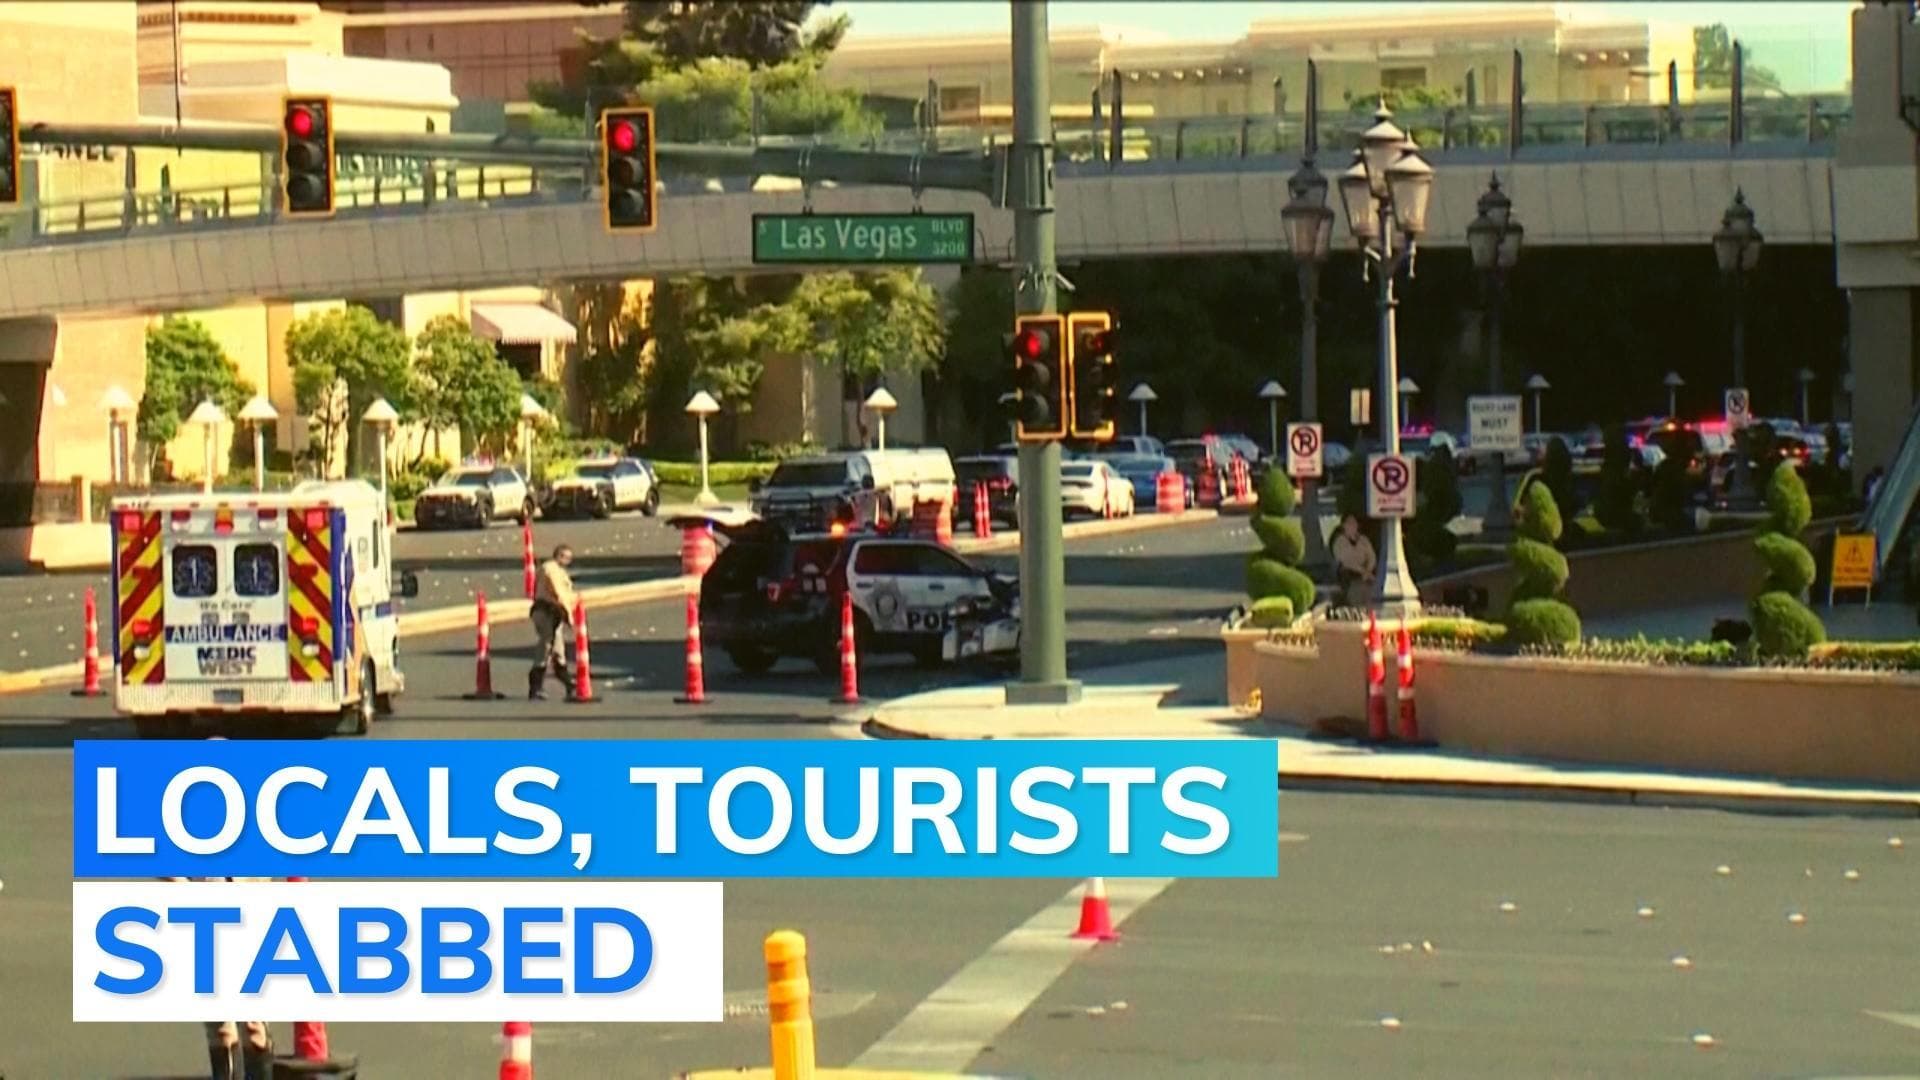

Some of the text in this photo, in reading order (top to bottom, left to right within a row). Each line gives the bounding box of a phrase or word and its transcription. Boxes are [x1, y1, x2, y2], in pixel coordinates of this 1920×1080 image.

[780, 219, 826, 249] Las
[834, 218, 917, 259] Vegas
[931, 219, 964, 233] BLVD
[171, 625, 281, 641] AMBULANCE
[197, 646, 256, 660] MEDIC
[199, 661, 254, 675] WEST
